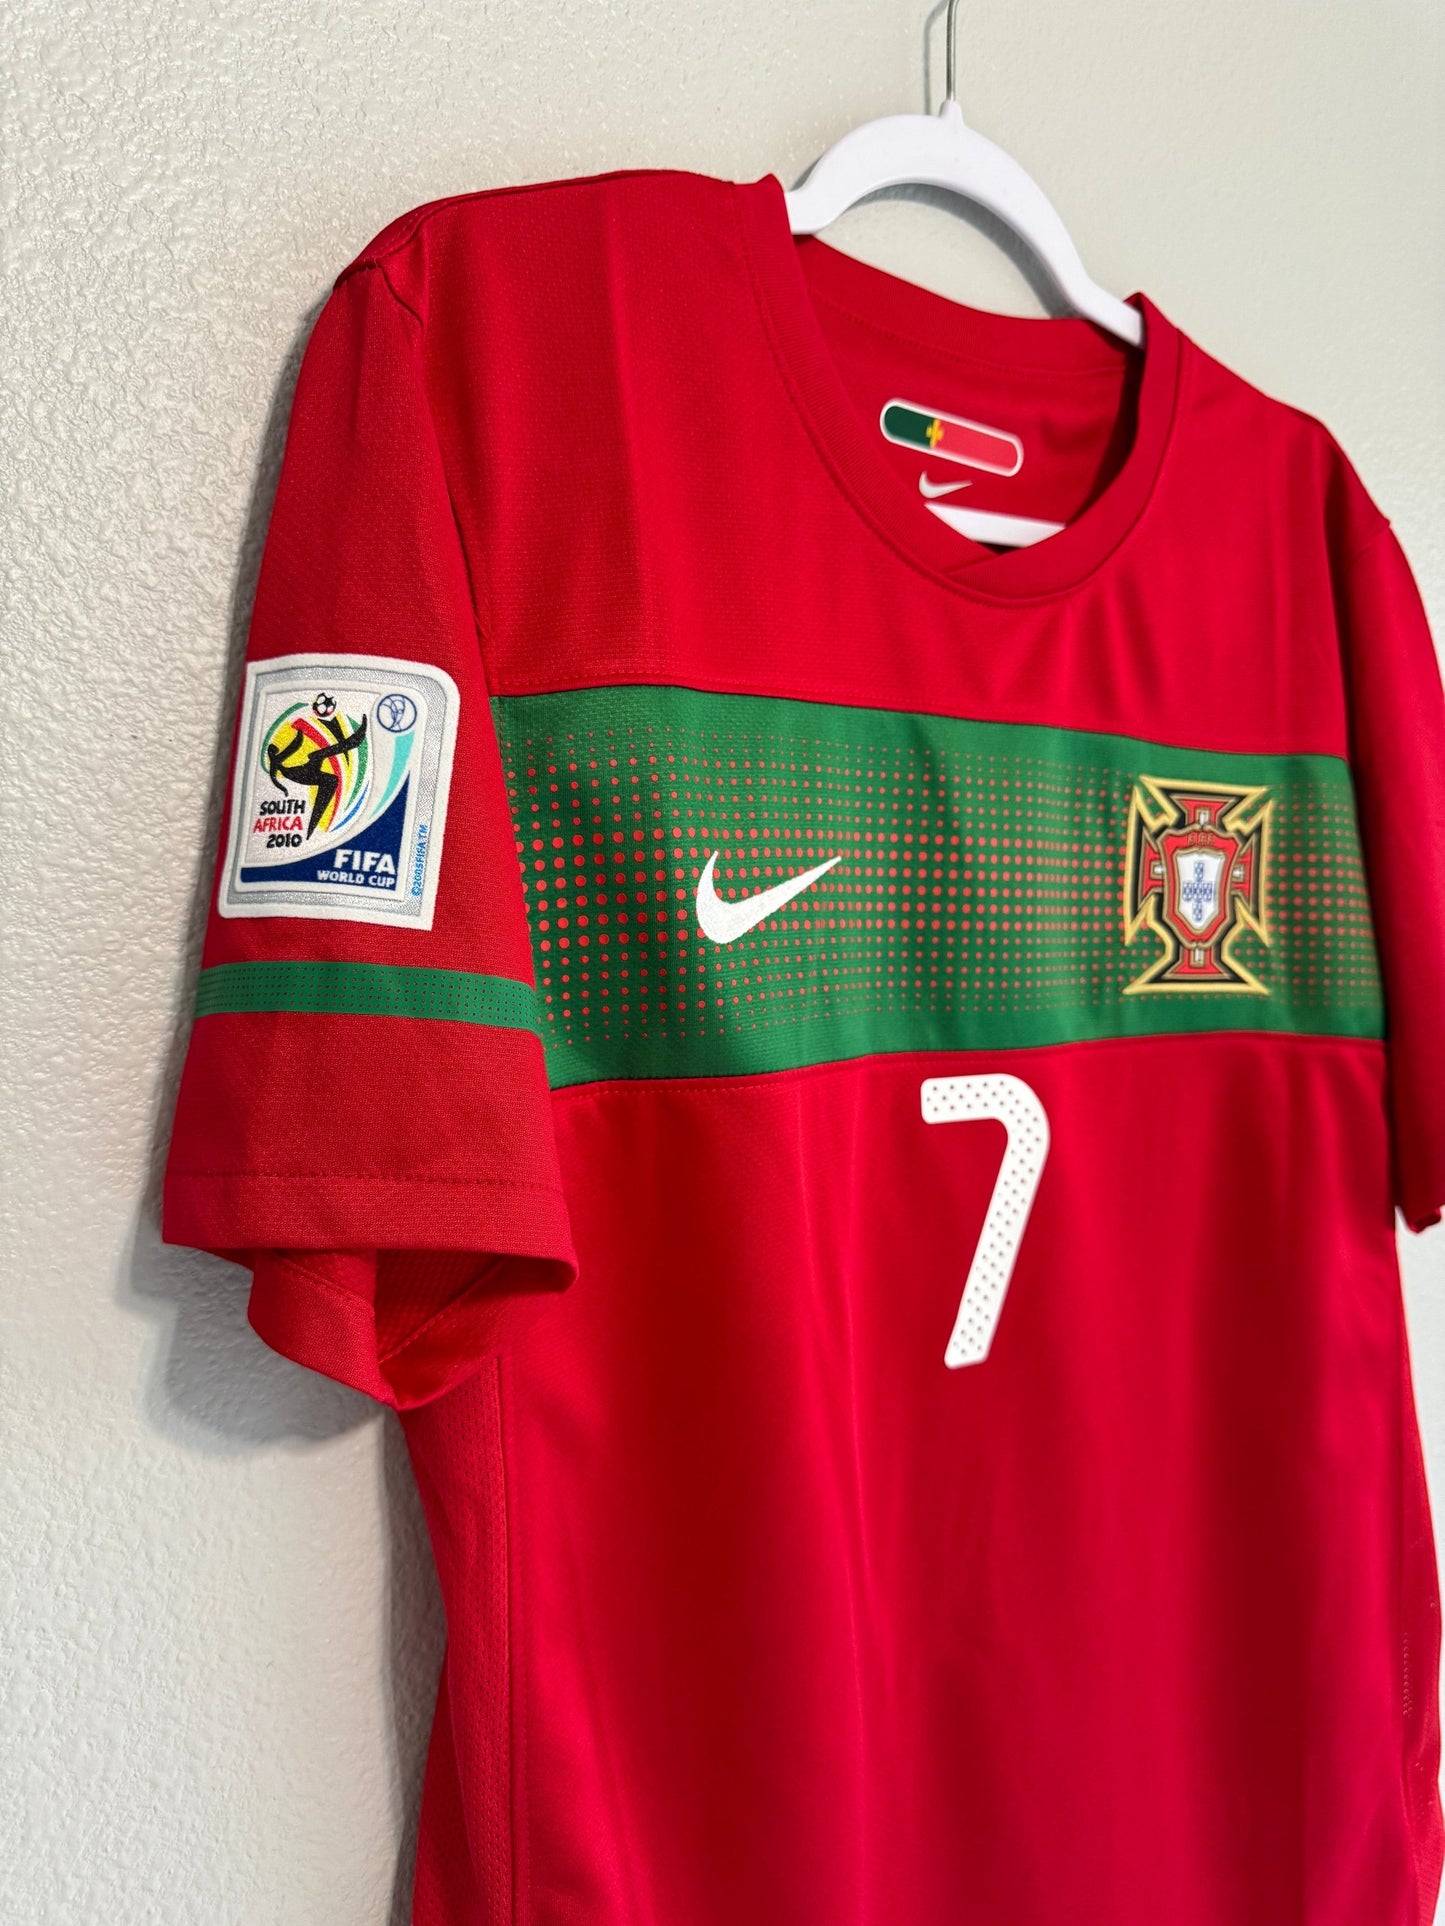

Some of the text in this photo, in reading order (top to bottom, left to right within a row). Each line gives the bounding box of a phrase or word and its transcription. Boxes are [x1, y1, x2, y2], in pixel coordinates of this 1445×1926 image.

[260, 800, 305, 815] SOUTH
[253, 816, 303, 832] AFRICA
[266, 834, 302, 848] 2010
[333, 849, 396, 874] FIFA
[317, 870, 395, 887] WORLD CUP
[920, 1072, 1051, 1369] 7
